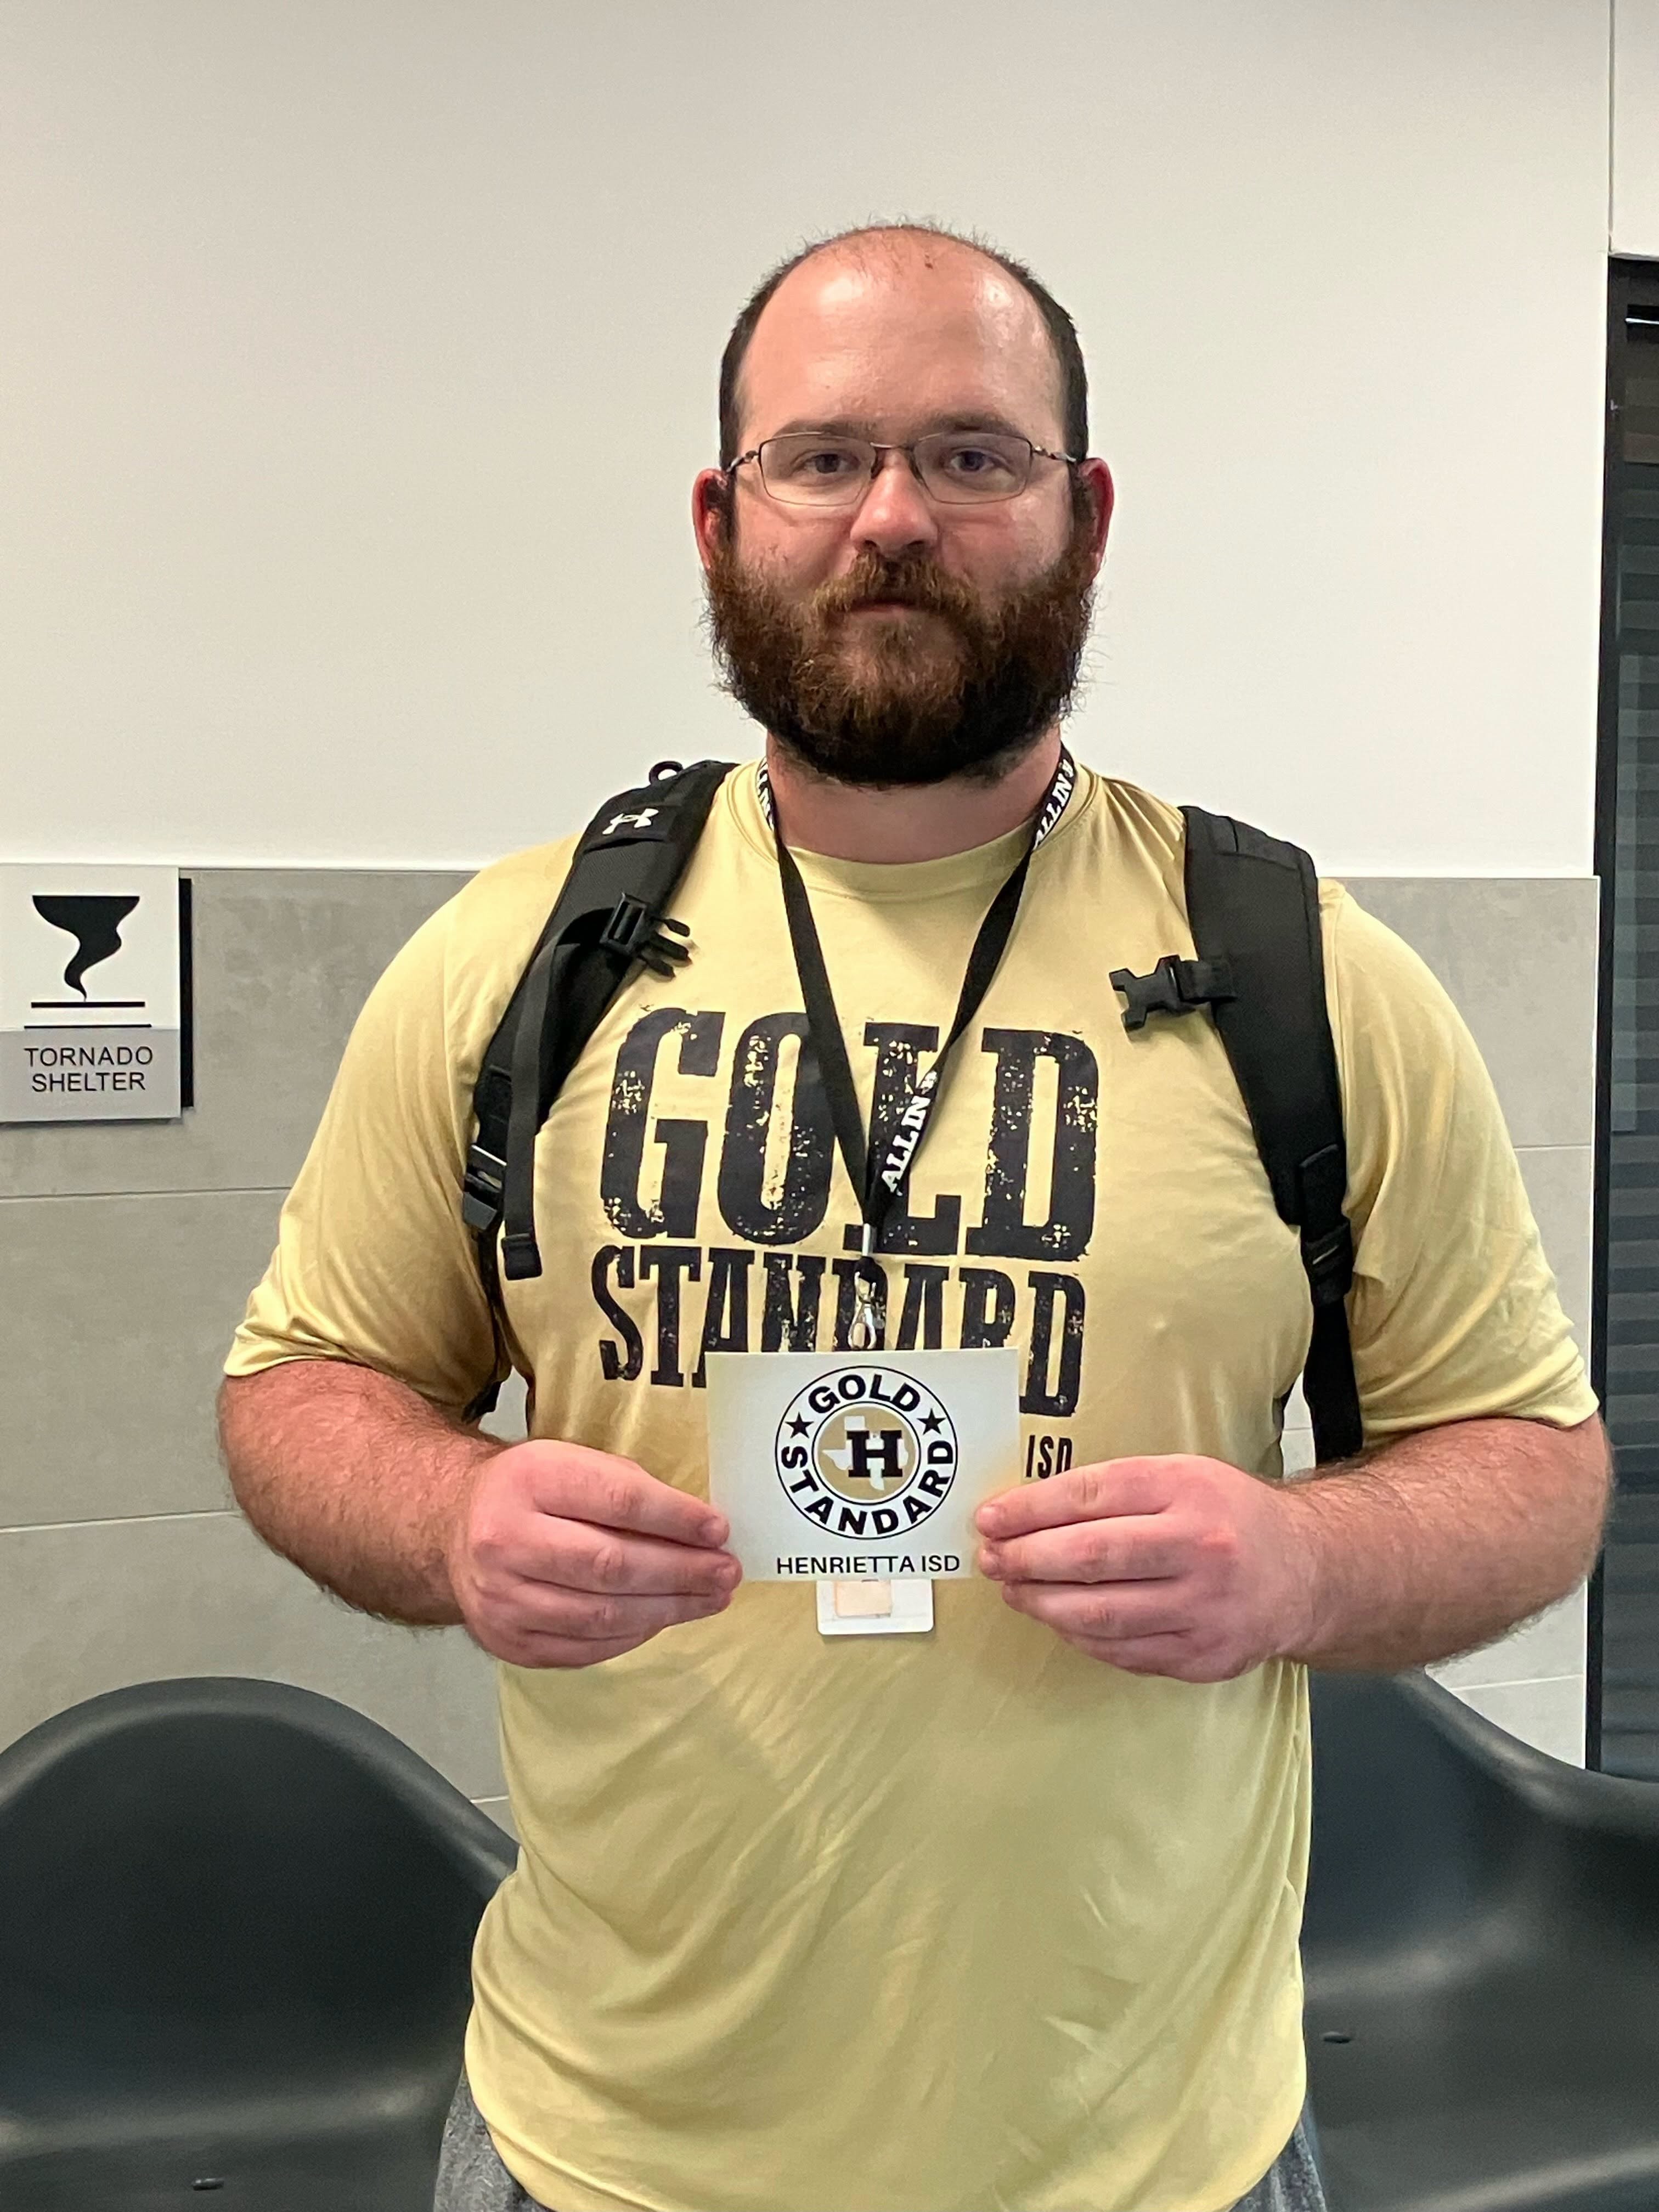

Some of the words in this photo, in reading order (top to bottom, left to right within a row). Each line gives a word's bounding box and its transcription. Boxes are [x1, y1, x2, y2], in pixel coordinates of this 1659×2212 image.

[24, 1046, 154, 1067] TORNADO
[31, 1072, 146, 1093] SHELTER
[600, 1007, 1099, 1262] GOLD
[881, 1130, 919, 1197] ALL
[901, 1095, 931, 1131] IN
[591, 1244, 1086, 1417] STANDARD
[808, 1373, 921, 1414] GOLD
[846, 1429, 904, 1479] H
[1025, 1435, 1073, 1479] ISD
[780, 1440, 954, 1536] STANDARD
[777, 1555, 915, 1575] HENRIETTA
[922, 1554, 960, 1573] ISD
